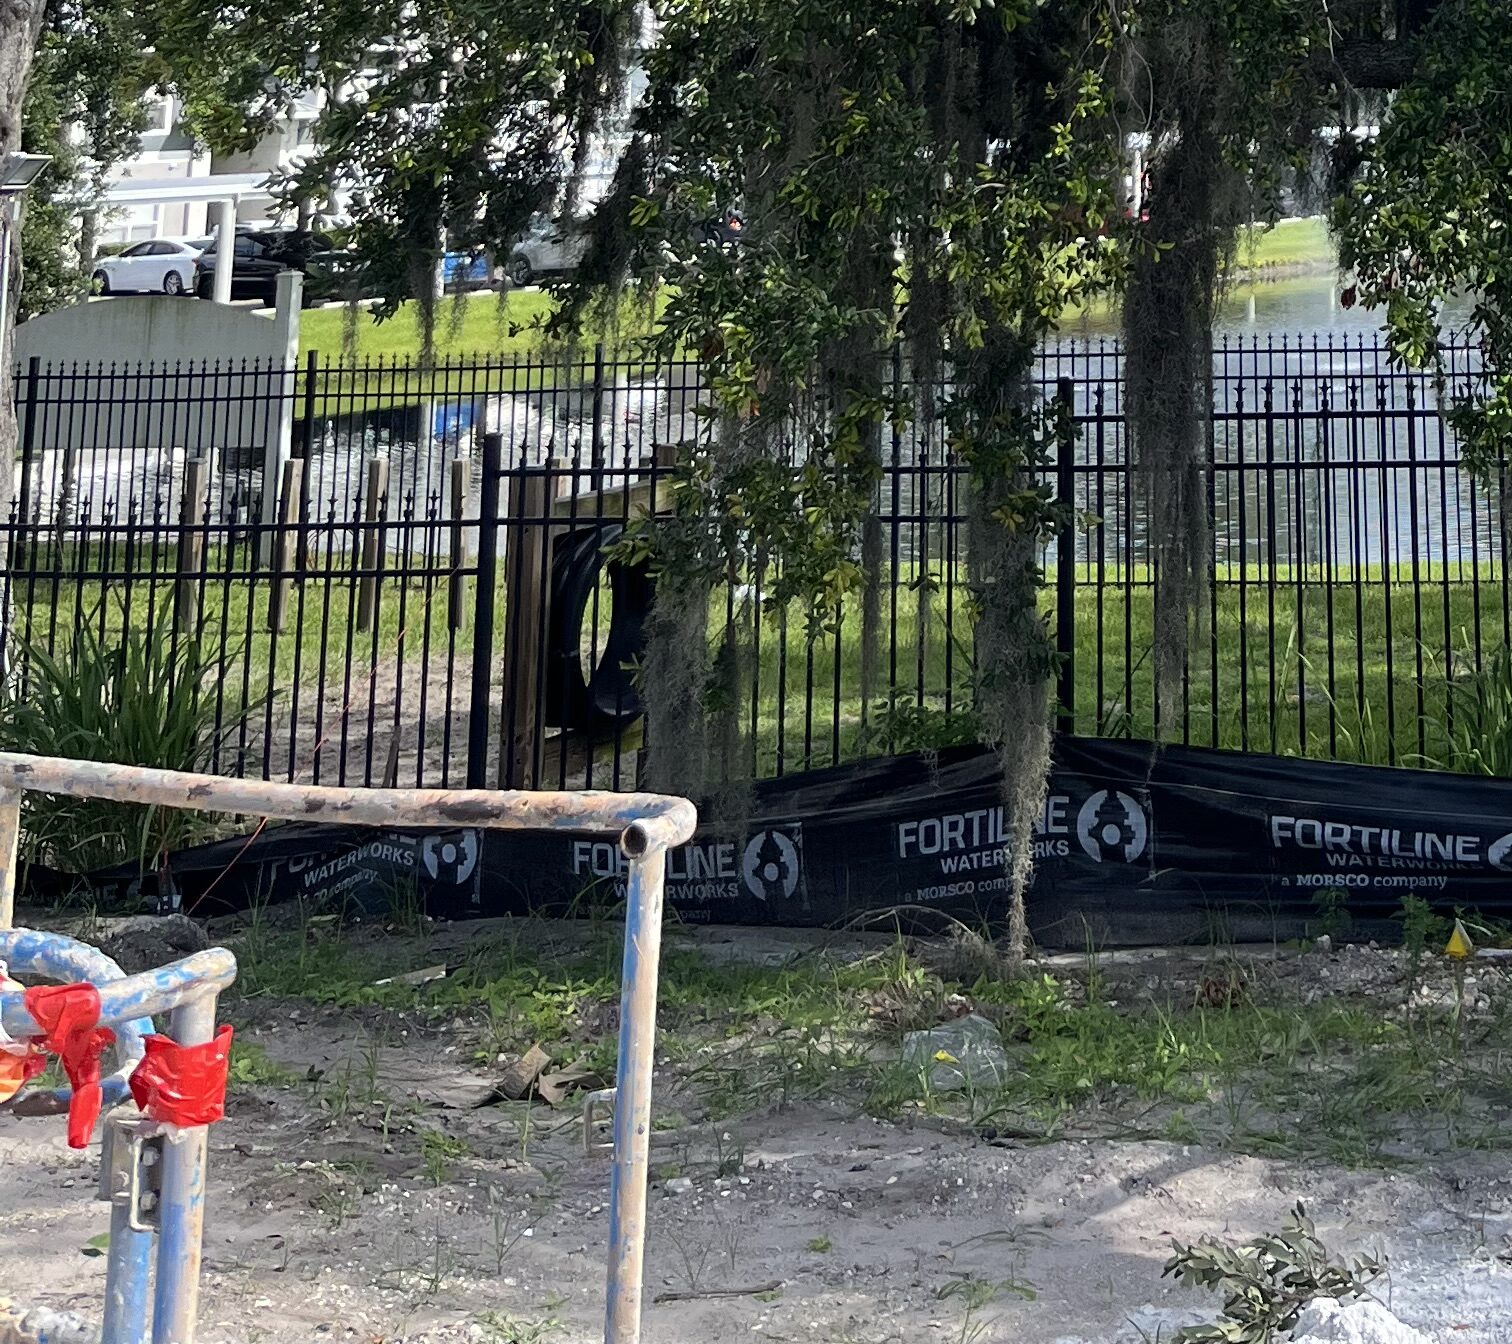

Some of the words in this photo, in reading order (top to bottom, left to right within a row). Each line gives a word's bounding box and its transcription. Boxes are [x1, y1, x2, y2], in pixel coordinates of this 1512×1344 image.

[1271, 815, 1480, 862] FORTILINE
[304, 842, 415, 887] WATERWORKS
[573, 841, 736, 879] FORLINE
[613, 882, 739, 898] WRWORKS
[917, 880, 975, 901] MORSCO
[1282, 876, 1290, 887] a
[1296, 874, 1370, 887] MORSCO
[1373, 875, 1448, 890] company
